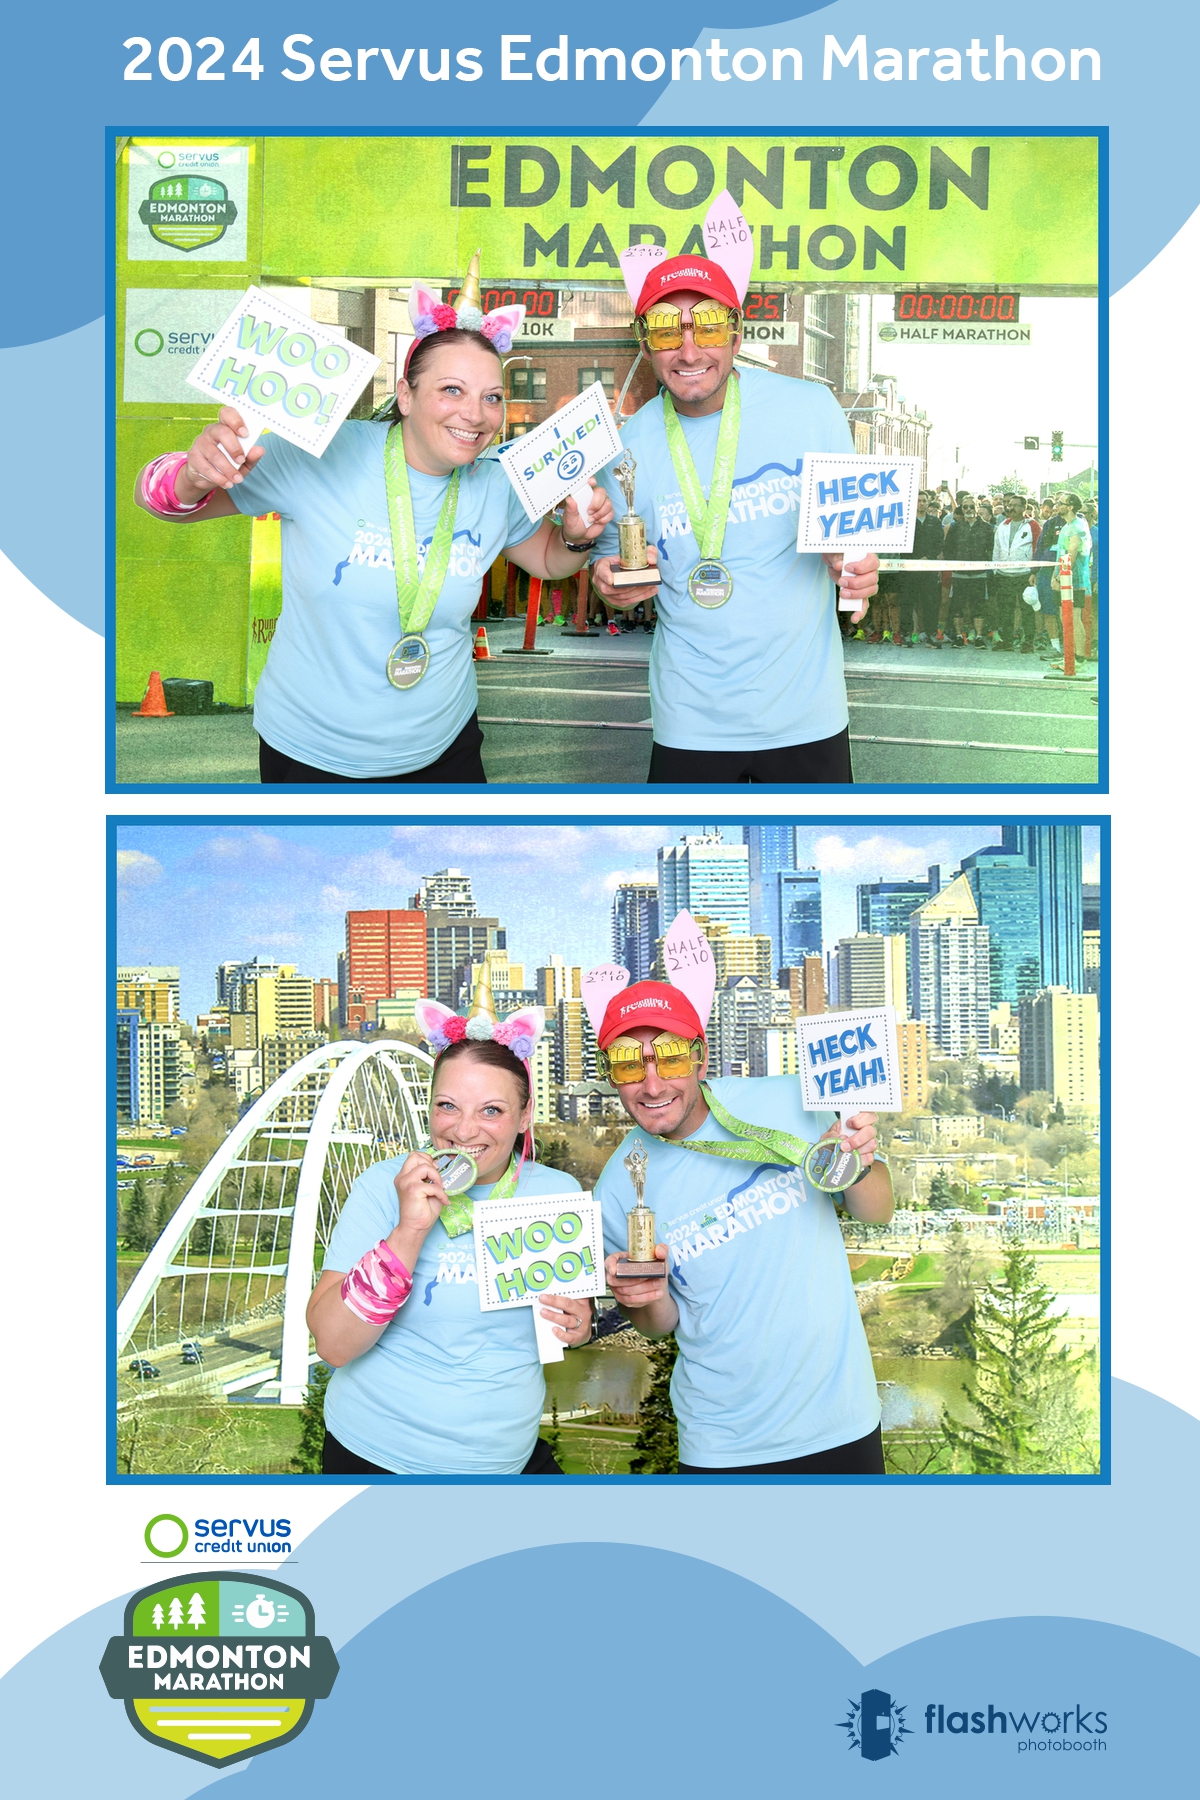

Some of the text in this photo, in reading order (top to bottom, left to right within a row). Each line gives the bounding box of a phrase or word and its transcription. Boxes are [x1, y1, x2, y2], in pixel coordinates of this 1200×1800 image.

[178, 152, 219, 161] servus
[450, 145, 990, 210] EDMONTON
[150, 203, 226, 214] EDMONTON
[160, 214, 216, 223] MARATHON
[706, 215, 744, 234] HALF
[523, 222, 906, 270] MARAHON
[708, 229, 748, 249] 2:10
[168, 331, 216, 345] serv
[521, 322, 555, 336] 10K
[900, 328, 1031, 341] HALF MARATHON
[168, 345, 200, 355] credit
[237, 314, 351, 379] WOO
[211, 356, 339, 426] HOO!
[553, 427, 561, 440] I
[523, 413, 602, 481] SURVIVED!
[816, 469, 900, 508] HECK
[658, 501, 686, 519] 202
[817, 502, 904, 541] YEAH!
[666, 935, 704, 956] HALF
[668, 949, 709, 972] 2:10
[585, 973, 625, 984] 2:10
[806, 1022, 878, 1068] HECK
[813, 1056, 887, 1100] YEAH!
[713, 1168, 803, 1219] EDMONTON
[668, 1212, 690, 1226] servus
[689, 1202, 708, 1216] credit
[670, 1182, 808, 1267] MARATHON
[484, 1212, 583, 1264] WOO
[665, 1220, 701, 1245] 2024
[437, 1251, 475, 1263] 2024
[494, 1246, 597, 1302] HOO!
